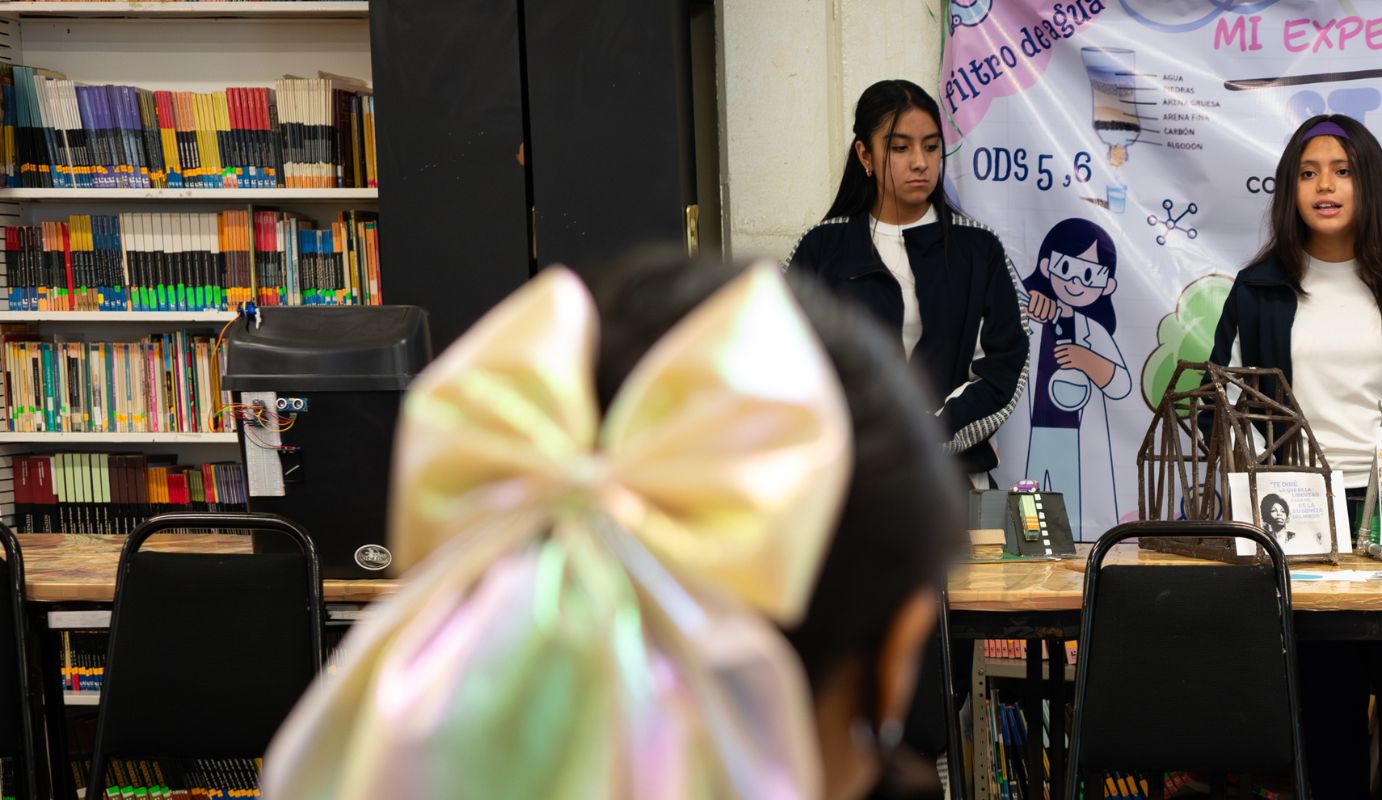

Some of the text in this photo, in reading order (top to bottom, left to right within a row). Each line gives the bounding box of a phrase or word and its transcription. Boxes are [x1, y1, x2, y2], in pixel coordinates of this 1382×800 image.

[1214, 15, 1263, 52] MI
[945, 45, 1017, 114] filtro
[1162, 74, 1184, 82] AGUA
[1163, 113, 1190, 121] ARENA
[973, 147, 1029, 182] ODS
